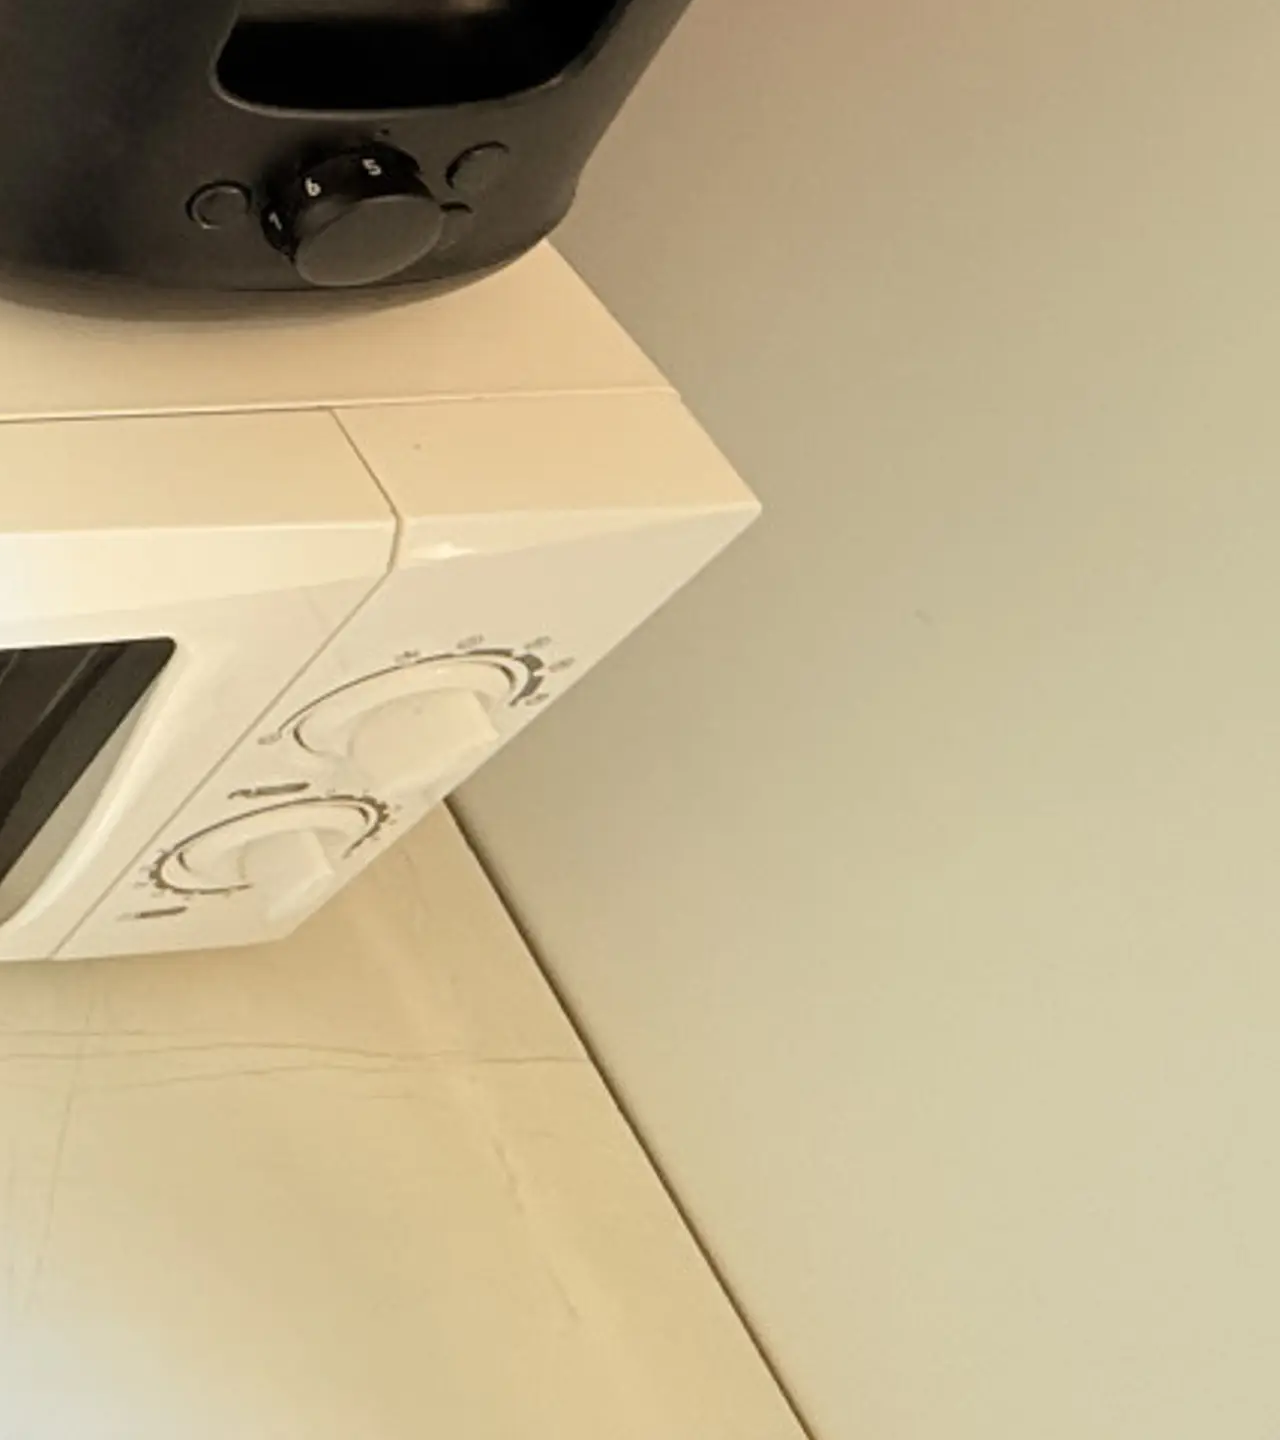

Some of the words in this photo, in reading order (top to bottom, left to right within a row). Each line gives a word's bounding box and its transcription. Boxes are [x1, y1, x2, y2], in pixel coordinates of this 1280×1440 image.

[361, 158, 383, 177] 5
[303, 177, 322, 198] 6
[267, 211, 284, 232] 1
